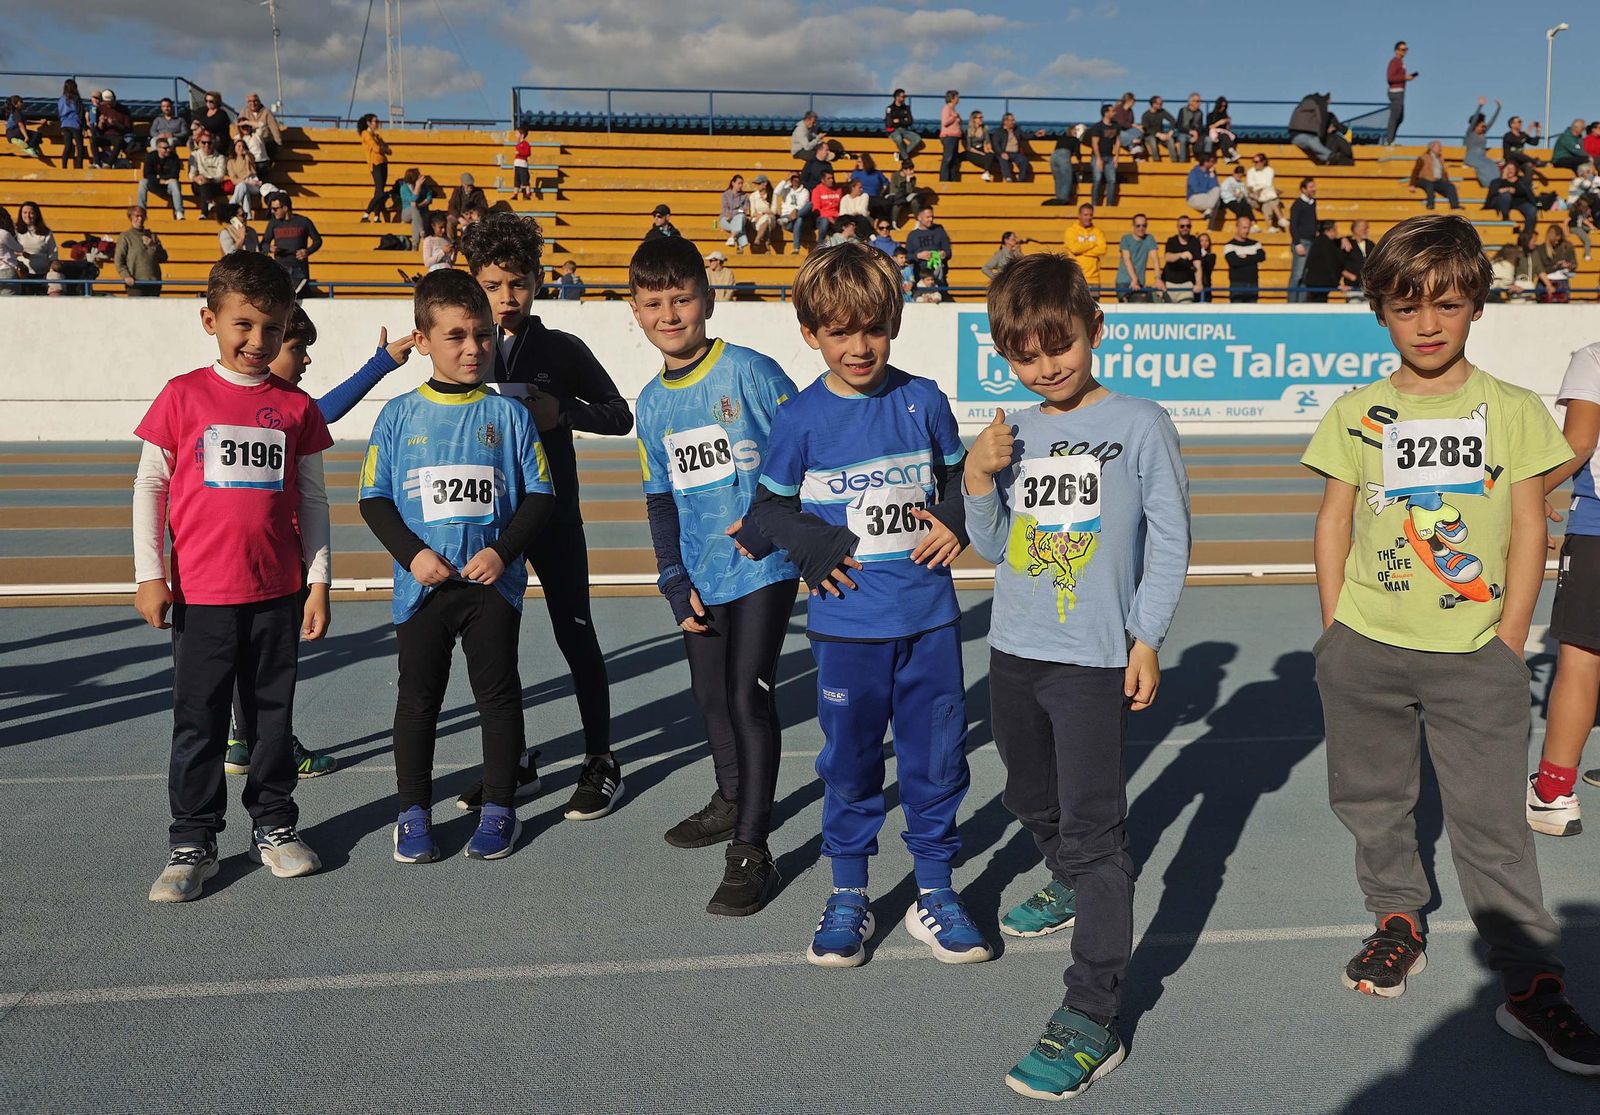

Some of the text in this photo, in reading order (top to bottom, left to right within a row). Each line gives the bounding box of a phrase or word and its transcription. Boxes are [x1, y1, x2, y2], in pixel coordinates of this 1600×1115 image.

[1134, 323, 1236, 340] MUNICIPAL
[1225, 343, 1402, 379] Talavera
[1182, 407, 1211, 416] SALA
[1226, 407, 1264, 416] RUGBY
[220, 439, 283, 470] 3196
[674, 438, 731, 474] 3268
[1396, 435, 1483, 470] 3283
[432, 478, 493, 505] 3248
[1023, 472, 1098, 508] 3269
[1377, 549, 1397, 561] THE
[1387, 558, 1412, 571] LIFE
[1377, 571, 1390, 582] OF
[1384, 580, 1410, 592] MAN
